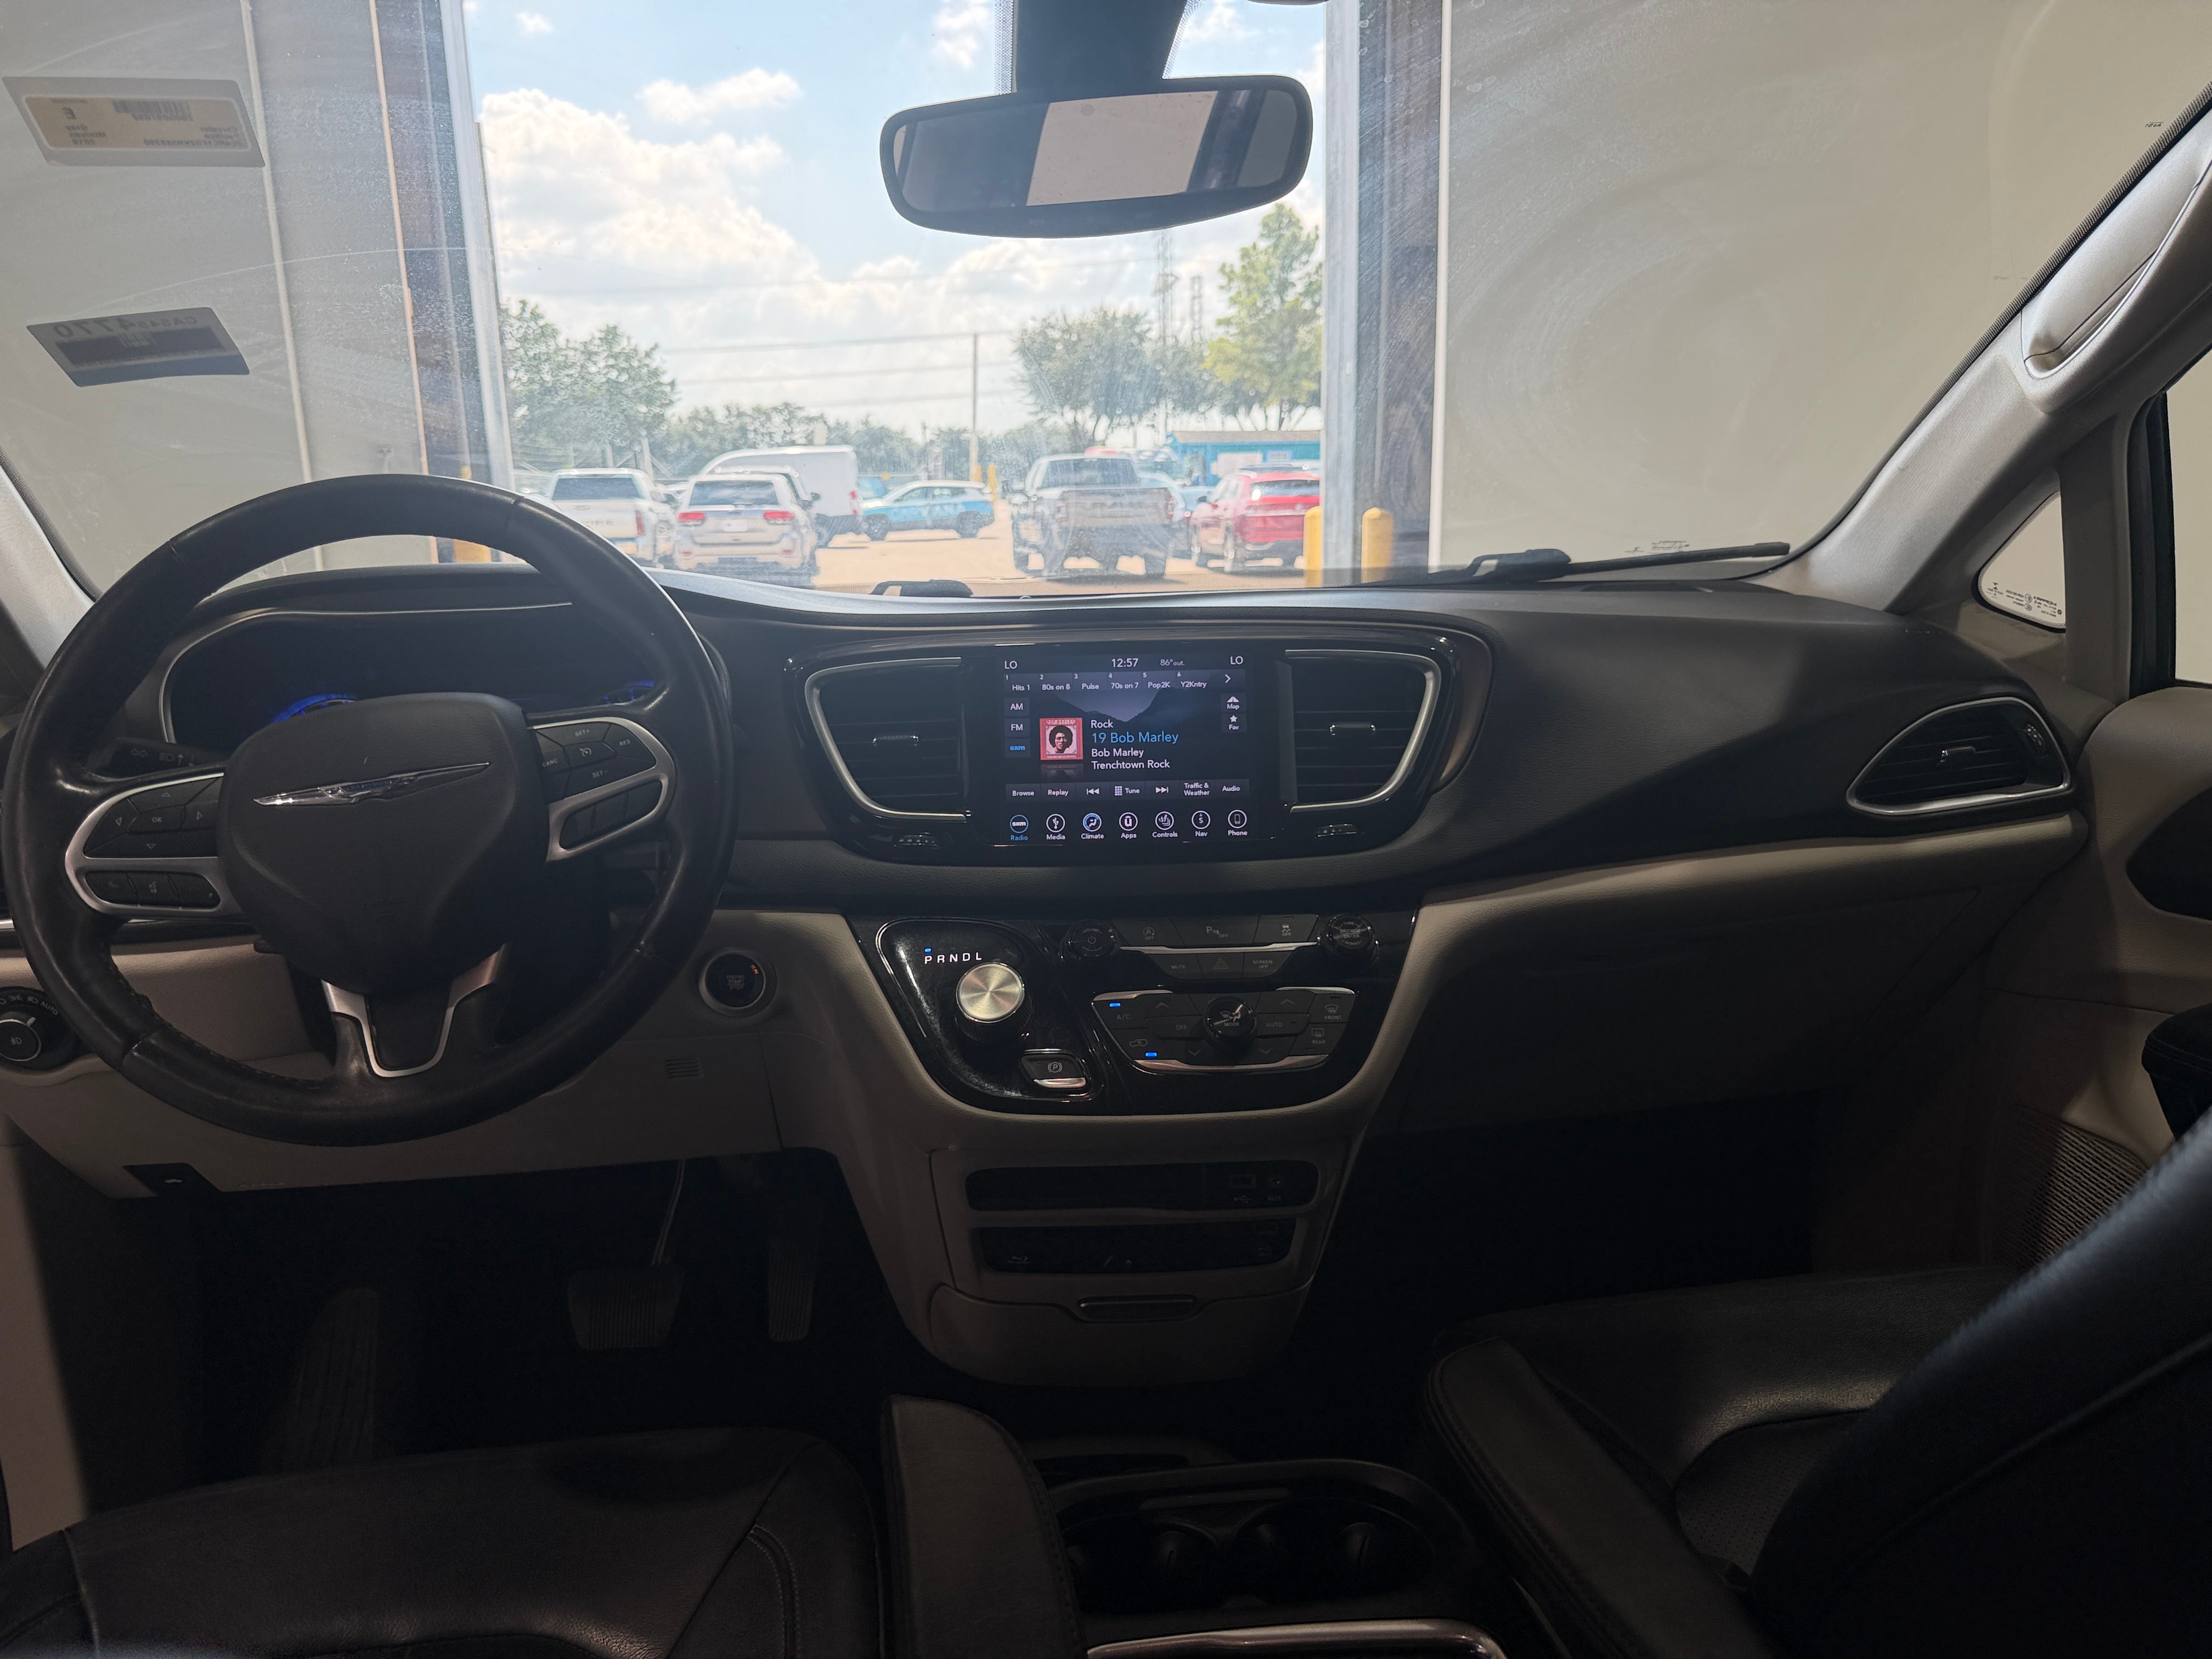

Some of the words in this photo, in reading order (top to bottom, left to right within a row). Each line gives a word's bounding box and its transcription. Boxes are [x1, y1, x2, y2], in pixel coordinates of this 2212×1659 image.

[1005, 661, 1017, 669] LO
[1111, 658, 1138, 667] 12:57
[1230, 656, 1243, 664] LO
[1091, 720, 1113, 728] Rock
[1092, 733, 1106, 743] 19
[1110, 732, 1135, 743] Bob
[1138, 732, 1178, 744] Marley
[1091, 749, 1110, 757] Bob
[1113, 748, 1144, 758] Marley
[542, 758, 558, 768] CANC
[1091, 760, 1144, 770] Trenchtown
[1148, 760, 1170, 768] Rock
[40, 1001, 59, 1015] AUTO
